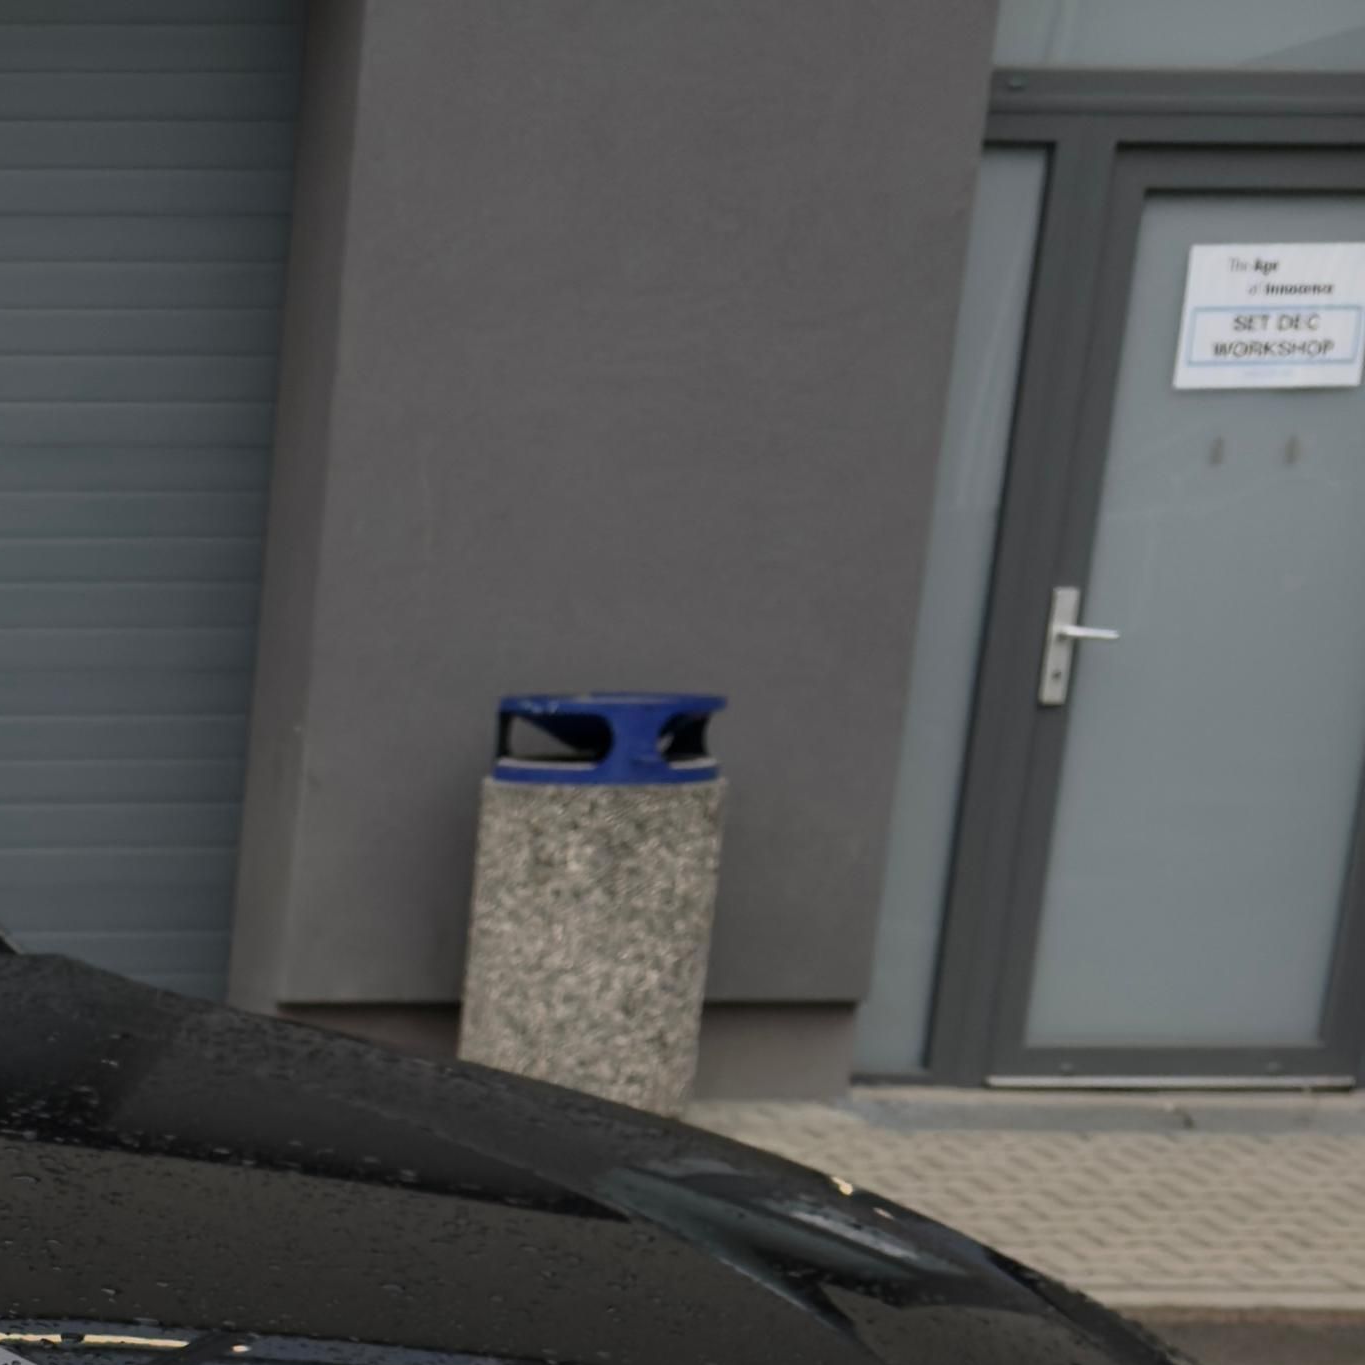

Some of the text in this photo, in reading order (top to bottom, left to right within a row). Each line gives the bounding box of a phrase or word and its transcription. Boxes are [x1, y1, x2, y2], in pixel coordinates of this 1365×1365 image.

[1232, 312, 1321, 332] SET DEC
[1213, 338, 1336, 358] WORKSHOP
